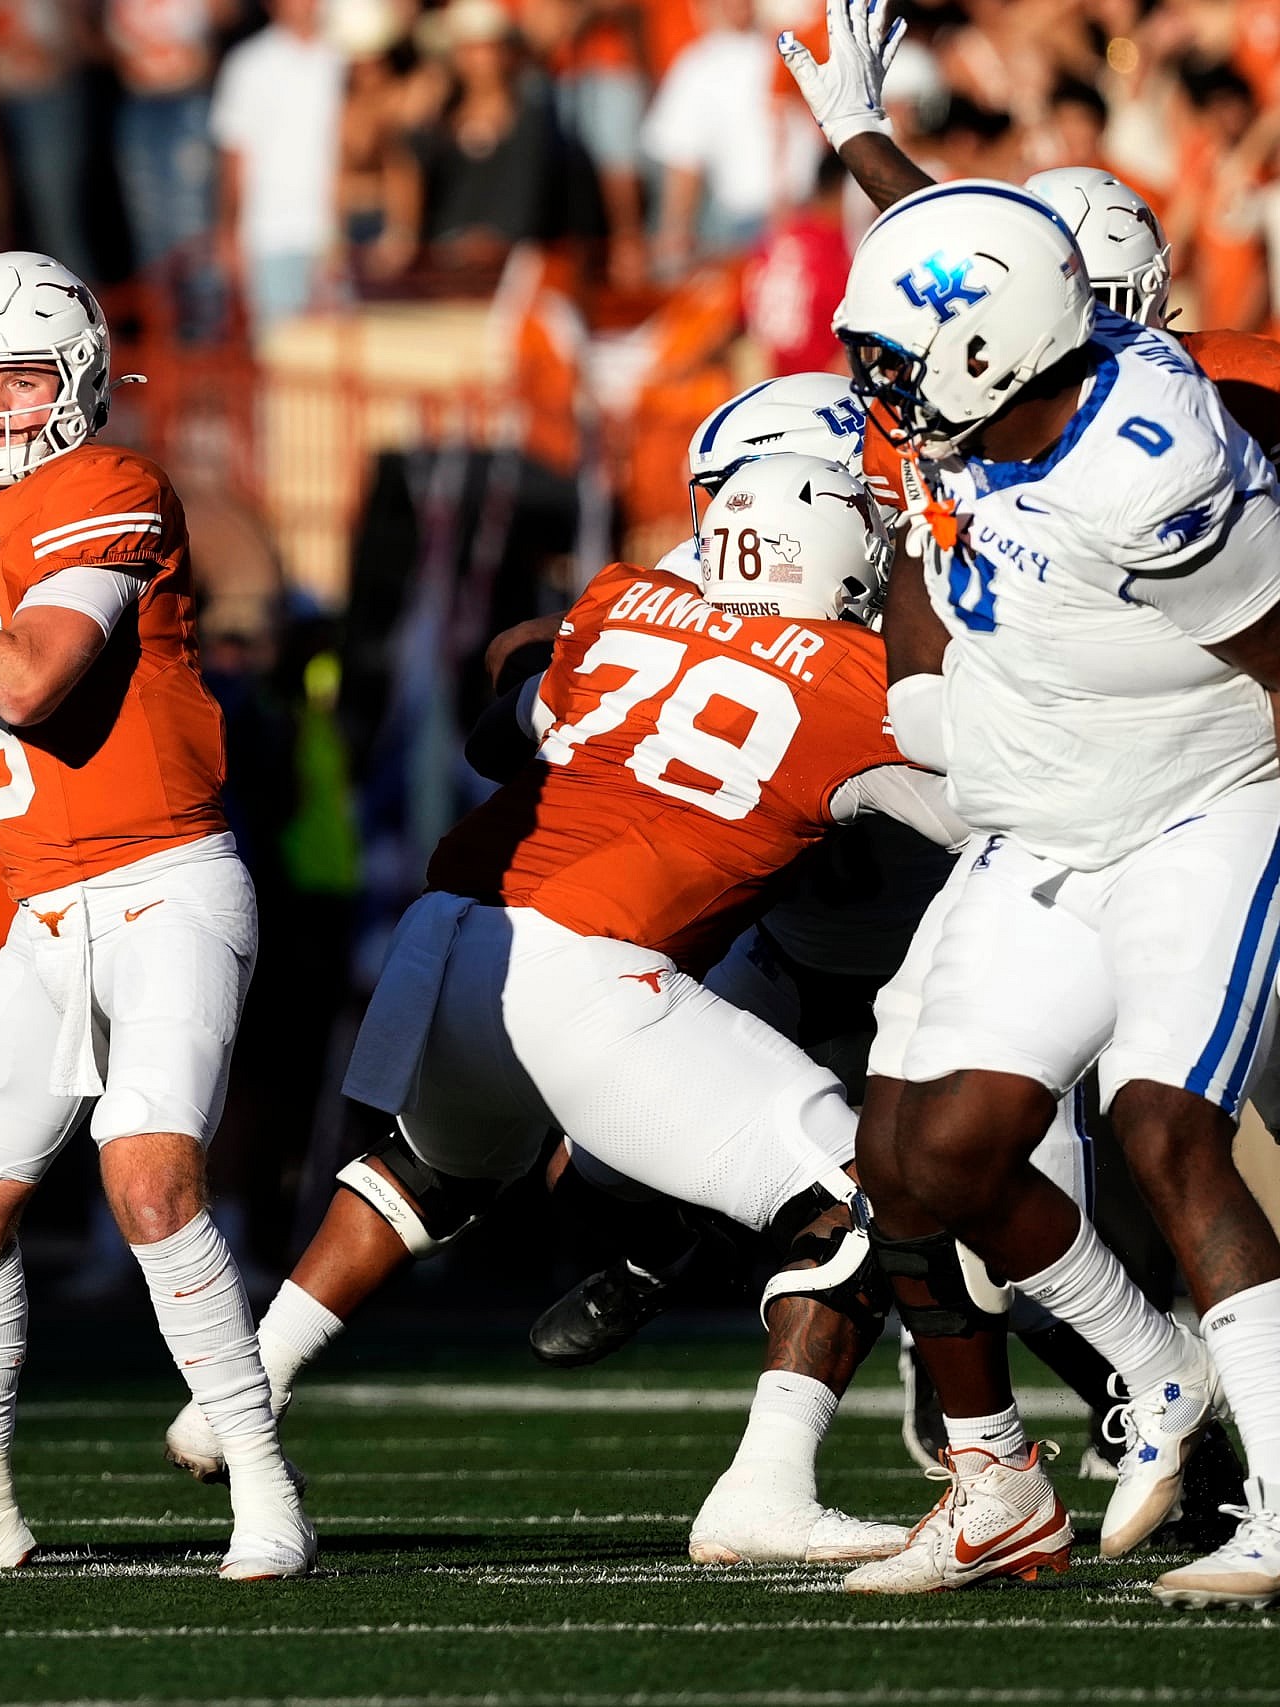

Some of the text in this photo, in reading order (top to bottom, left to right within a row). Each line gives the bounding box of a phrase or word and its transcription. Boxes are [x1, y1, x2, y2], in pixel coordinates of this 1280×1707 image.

[713, 527, 762, 581] 78
[608, 582, 825, 682] BANKS JR.
[535, 629, 802, 821] 78
